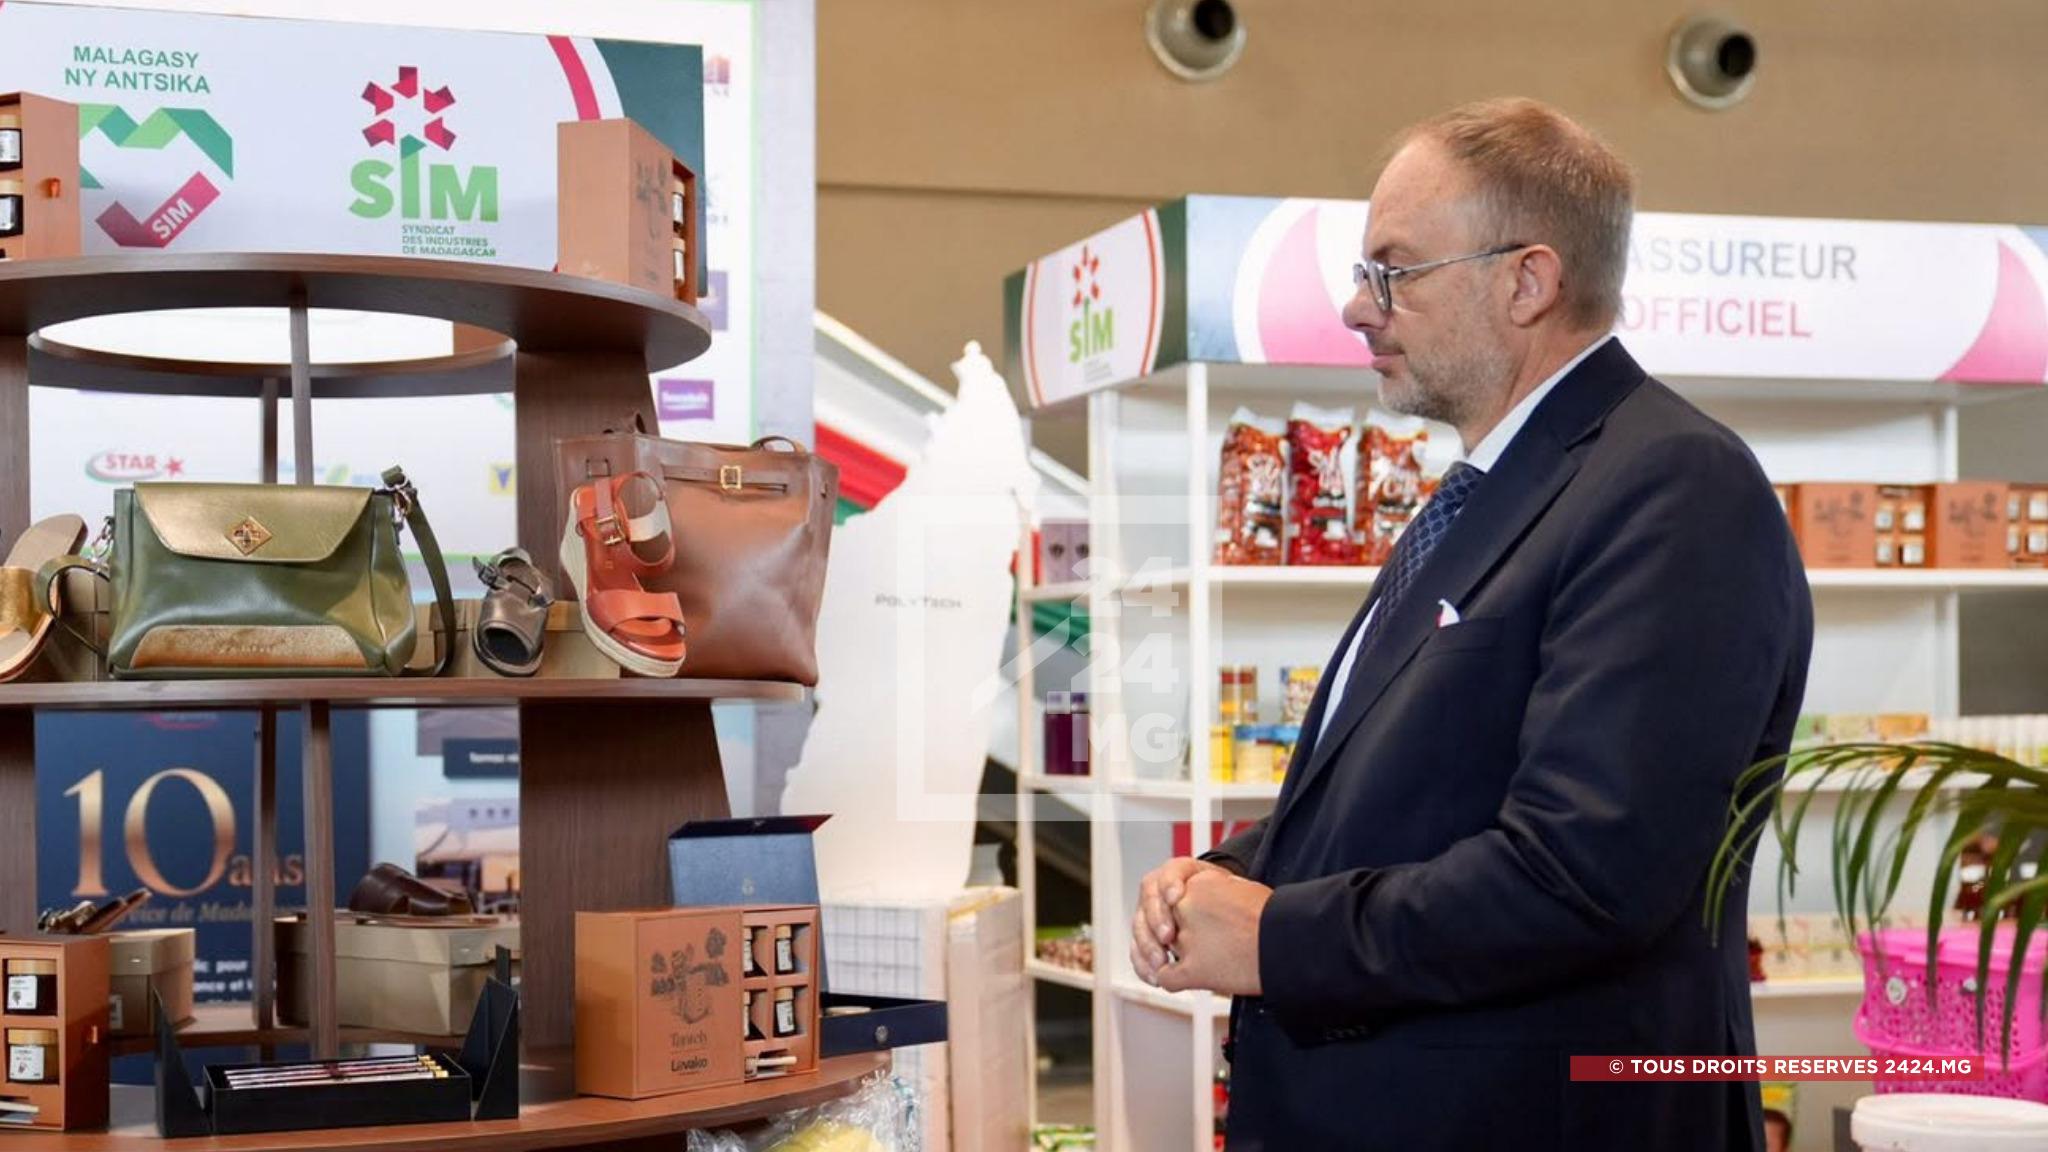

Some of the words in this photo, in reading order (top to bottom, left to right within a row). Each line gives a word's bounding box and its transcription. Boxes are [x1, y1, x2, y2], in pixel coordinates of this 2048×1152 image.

[73, 46, 200, 68] MALAGASY
[64, 69, 97, 86] NY
[104, 70, 211, 94] ANTSIKA
[349, 134, 498, 222] SIM
[152, 197, 194, 240] SIM
[402, 224, 455, 235] SYNDICAT
[402, 236, 422, 245] DES
[425, 236, 488, 247] INDUSTRIES
[402, 246, 417, 255] DE
[420, 247, 496, 257] MADAGASCAR
[1069, 296, 1114, 363] SIM
[1621, 296, 1812, 338] OFFICIEL
[105, 453, 158, 470] STAR
[63, 767, 236, 897] 10
[229, 855, 305, 887] as
